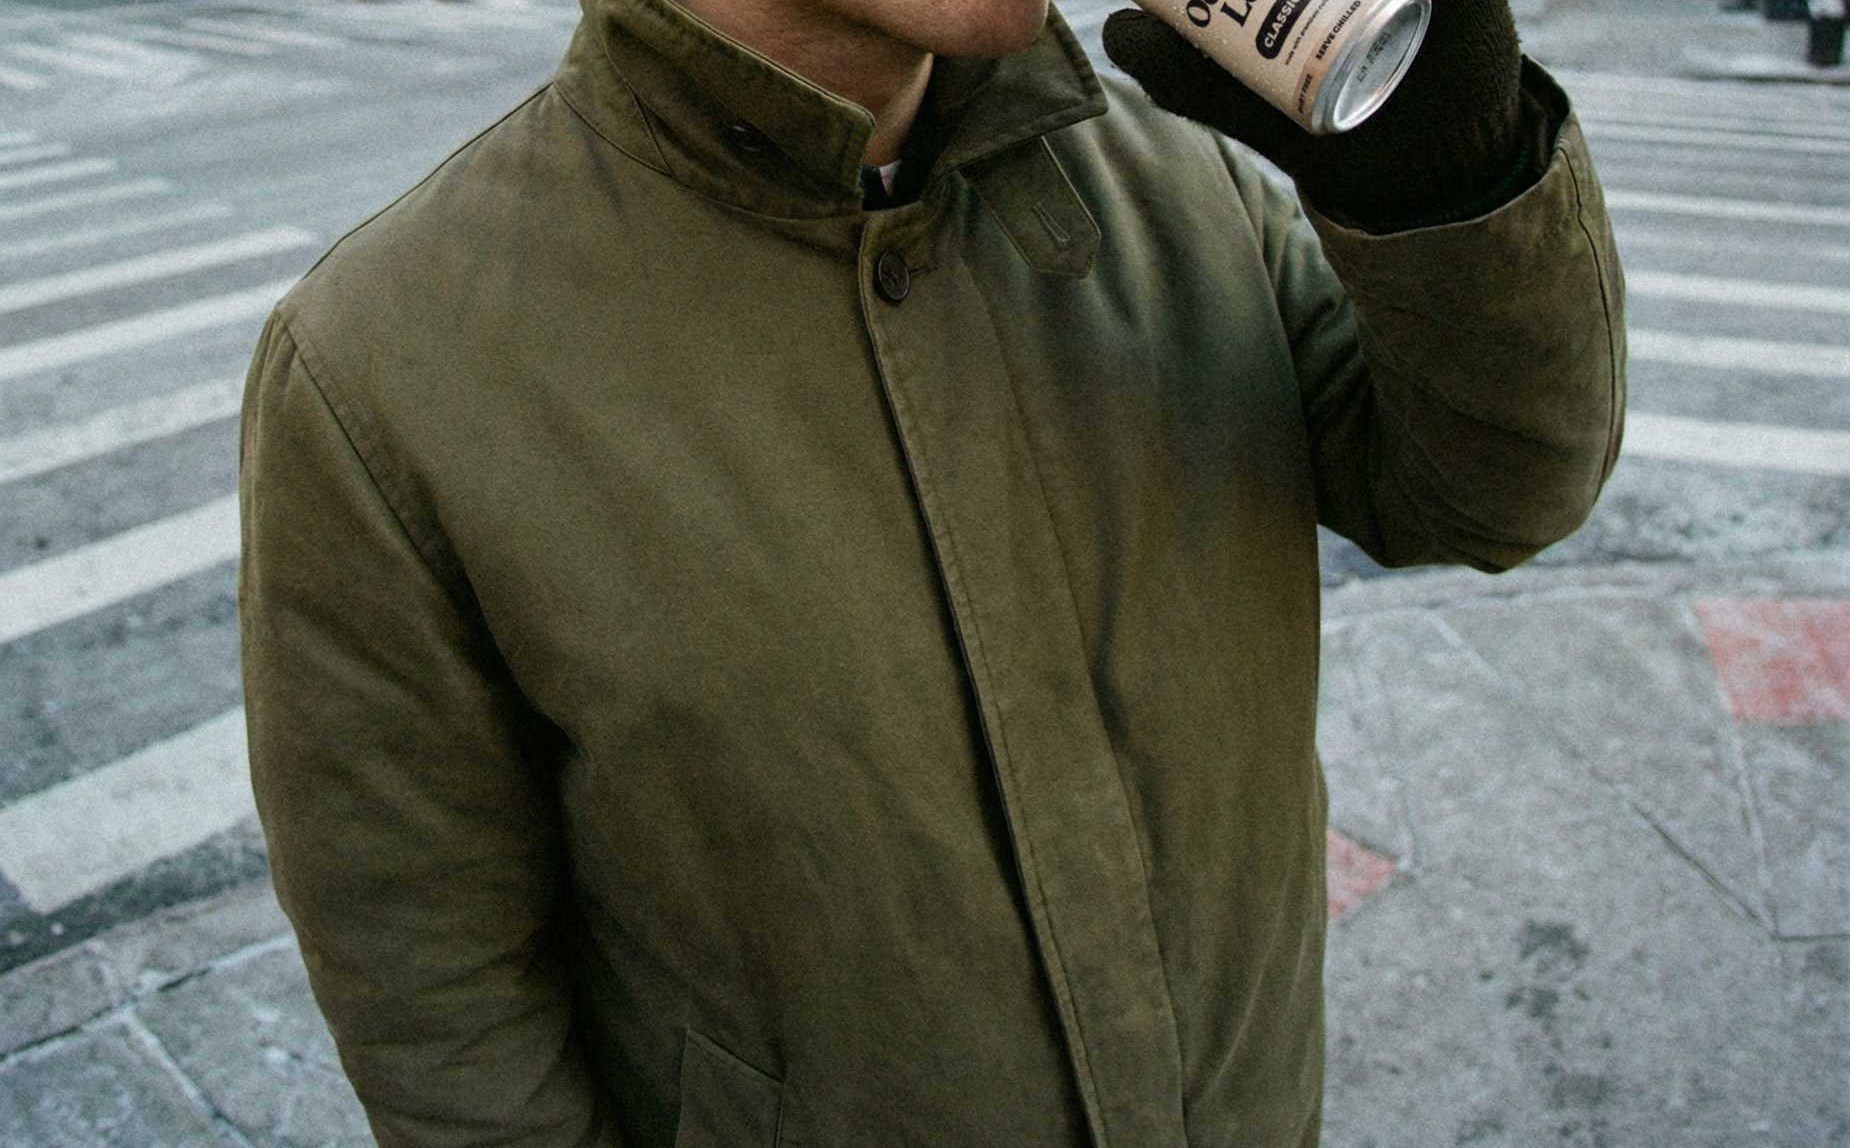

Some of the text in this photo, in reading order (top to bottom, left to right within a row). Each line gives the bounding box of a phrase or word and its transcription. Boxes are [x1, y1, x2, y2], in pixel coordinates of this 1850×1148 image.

[1315, 0, 1361, 61] SERVE CHILLED
[1293, 36, 1302, 50] with
[1300, 73, 1313, 97] FREE
